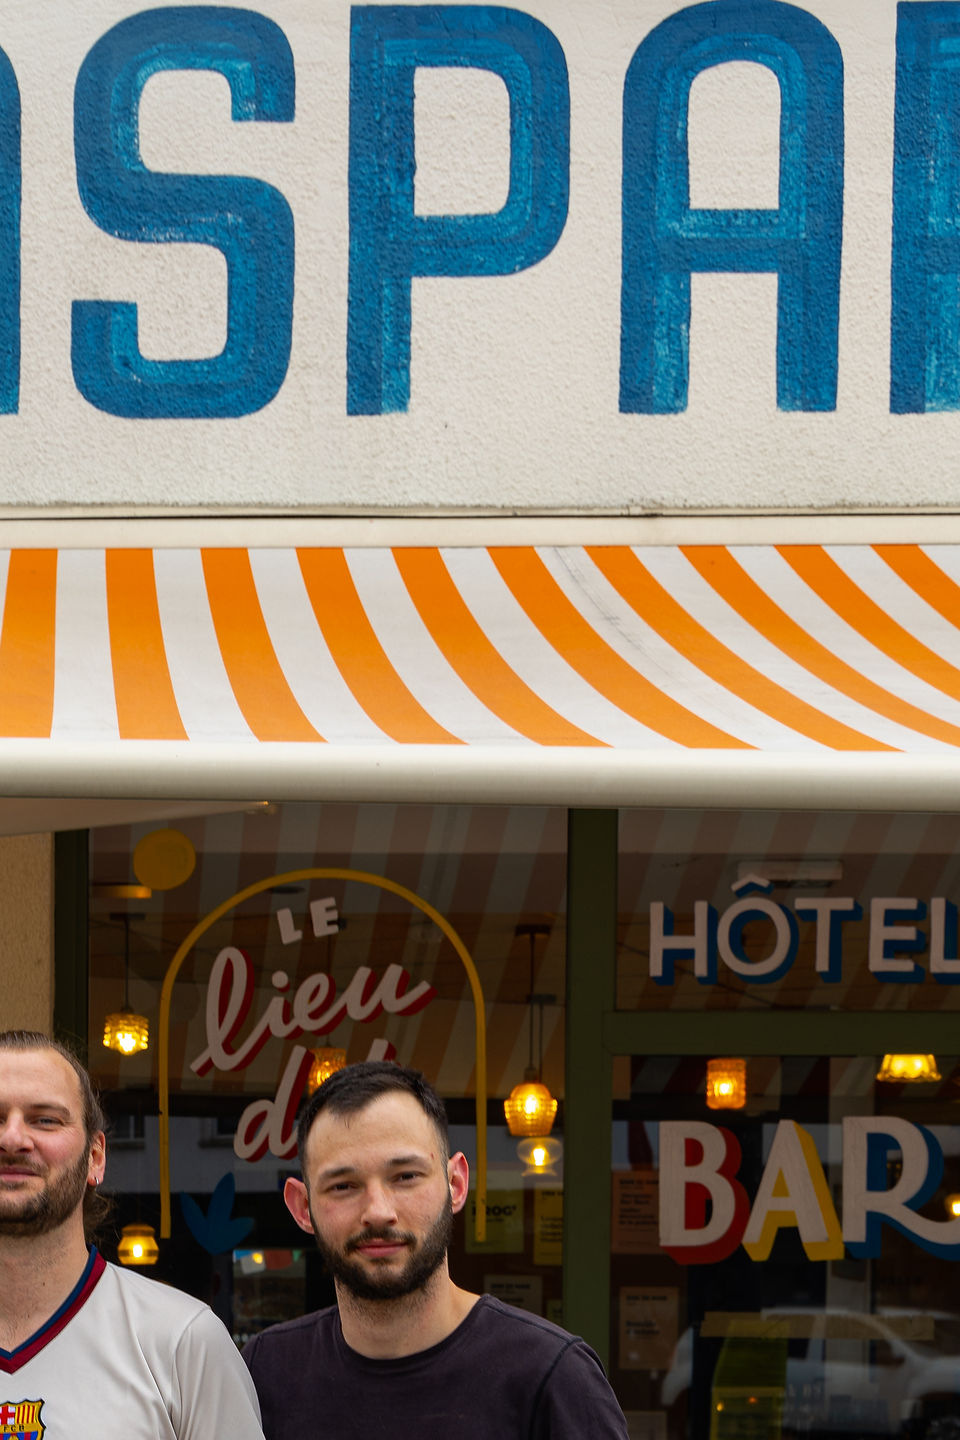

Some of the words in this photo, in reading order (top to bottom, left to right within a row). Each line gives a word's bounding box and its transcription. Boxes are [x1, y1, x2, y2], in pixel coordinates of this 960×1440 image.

[276, 897, 340, 944] LE
[649, 873, 960, 986] HÔTEL
[190, 946, 437, 1077] lieu
[658, 1115, 960, 1264] BAR
